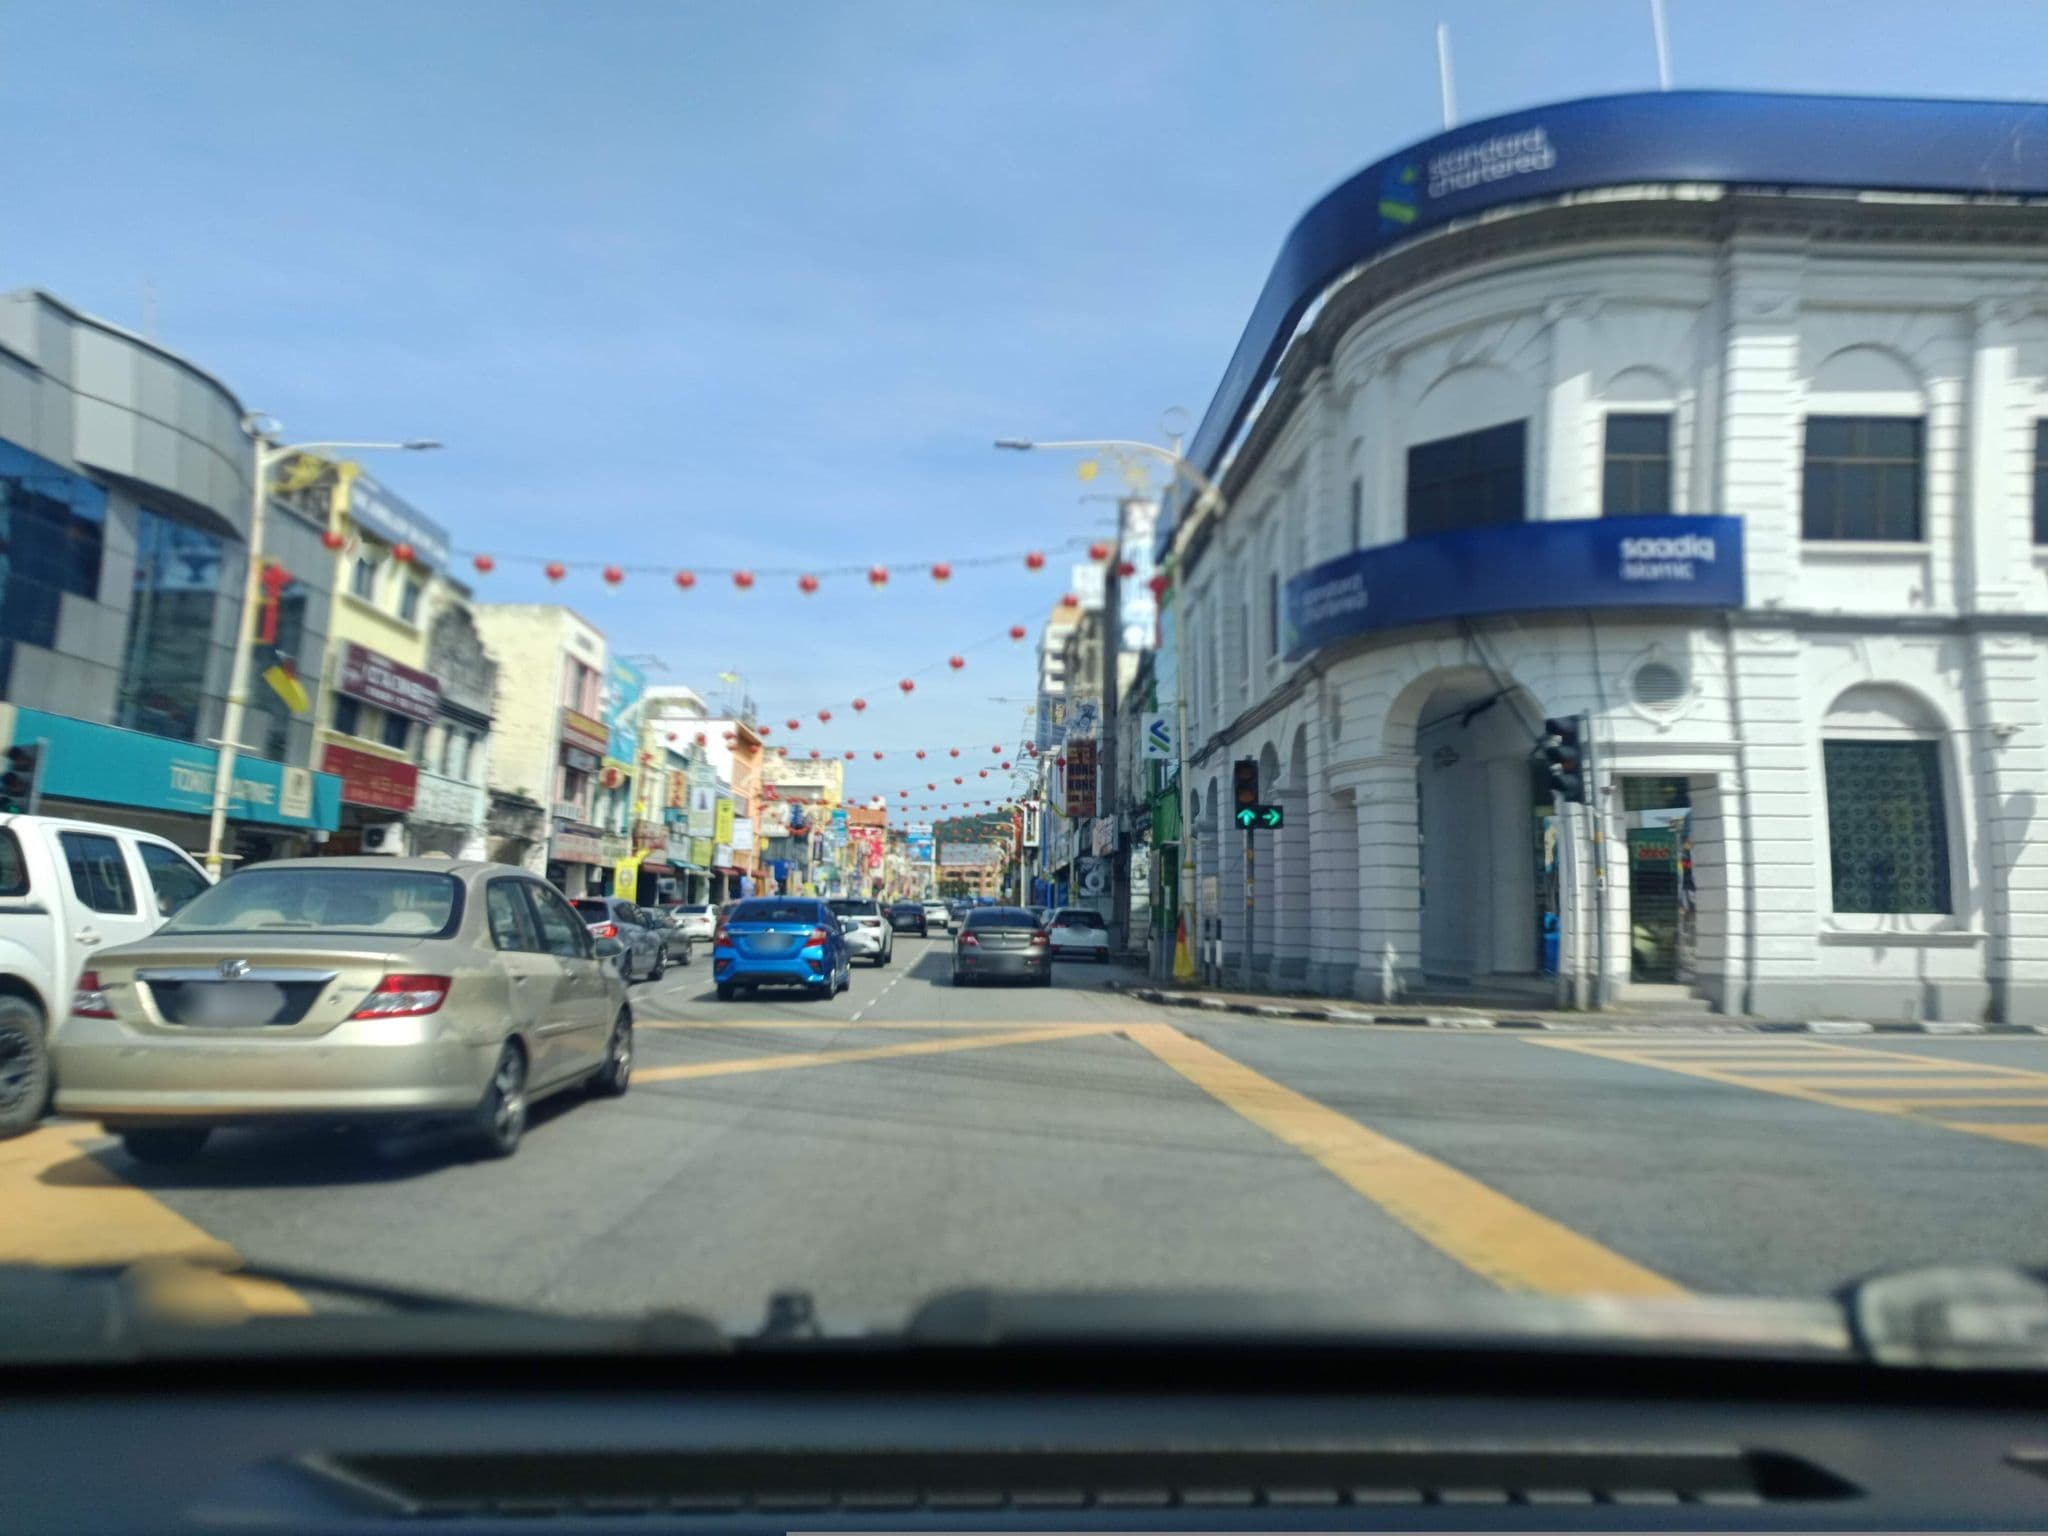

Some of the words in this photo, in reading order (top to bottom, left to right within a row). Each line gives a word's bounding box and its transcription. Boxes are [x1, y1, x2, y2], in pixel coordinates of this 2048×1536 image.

[1428, 146, 1556, 198] chartered
[1429, 127, 1546, 179] standard
[1620, 534, 1715, 562] saadiq
